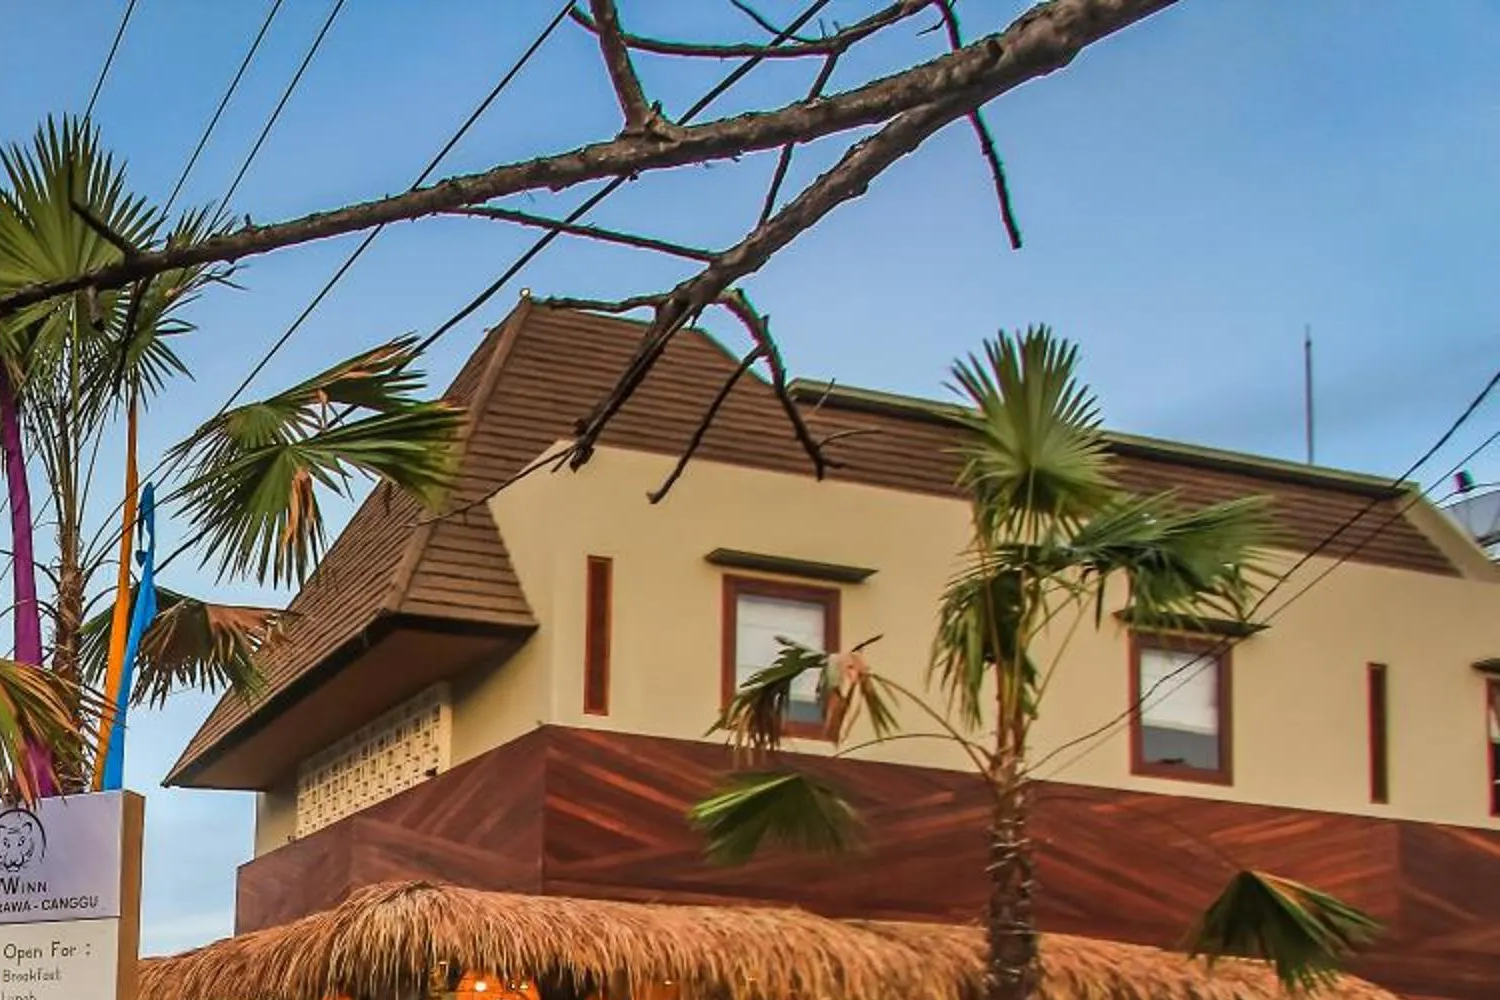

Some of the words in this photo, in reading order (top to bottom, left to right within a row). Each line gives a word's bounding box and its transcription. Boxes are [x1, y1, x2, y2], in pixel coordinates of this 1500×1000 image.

[41, 895, 99, 911] CANGGU
[3, 943, 43, 966] Open
[51, 941, 77, 957] For
